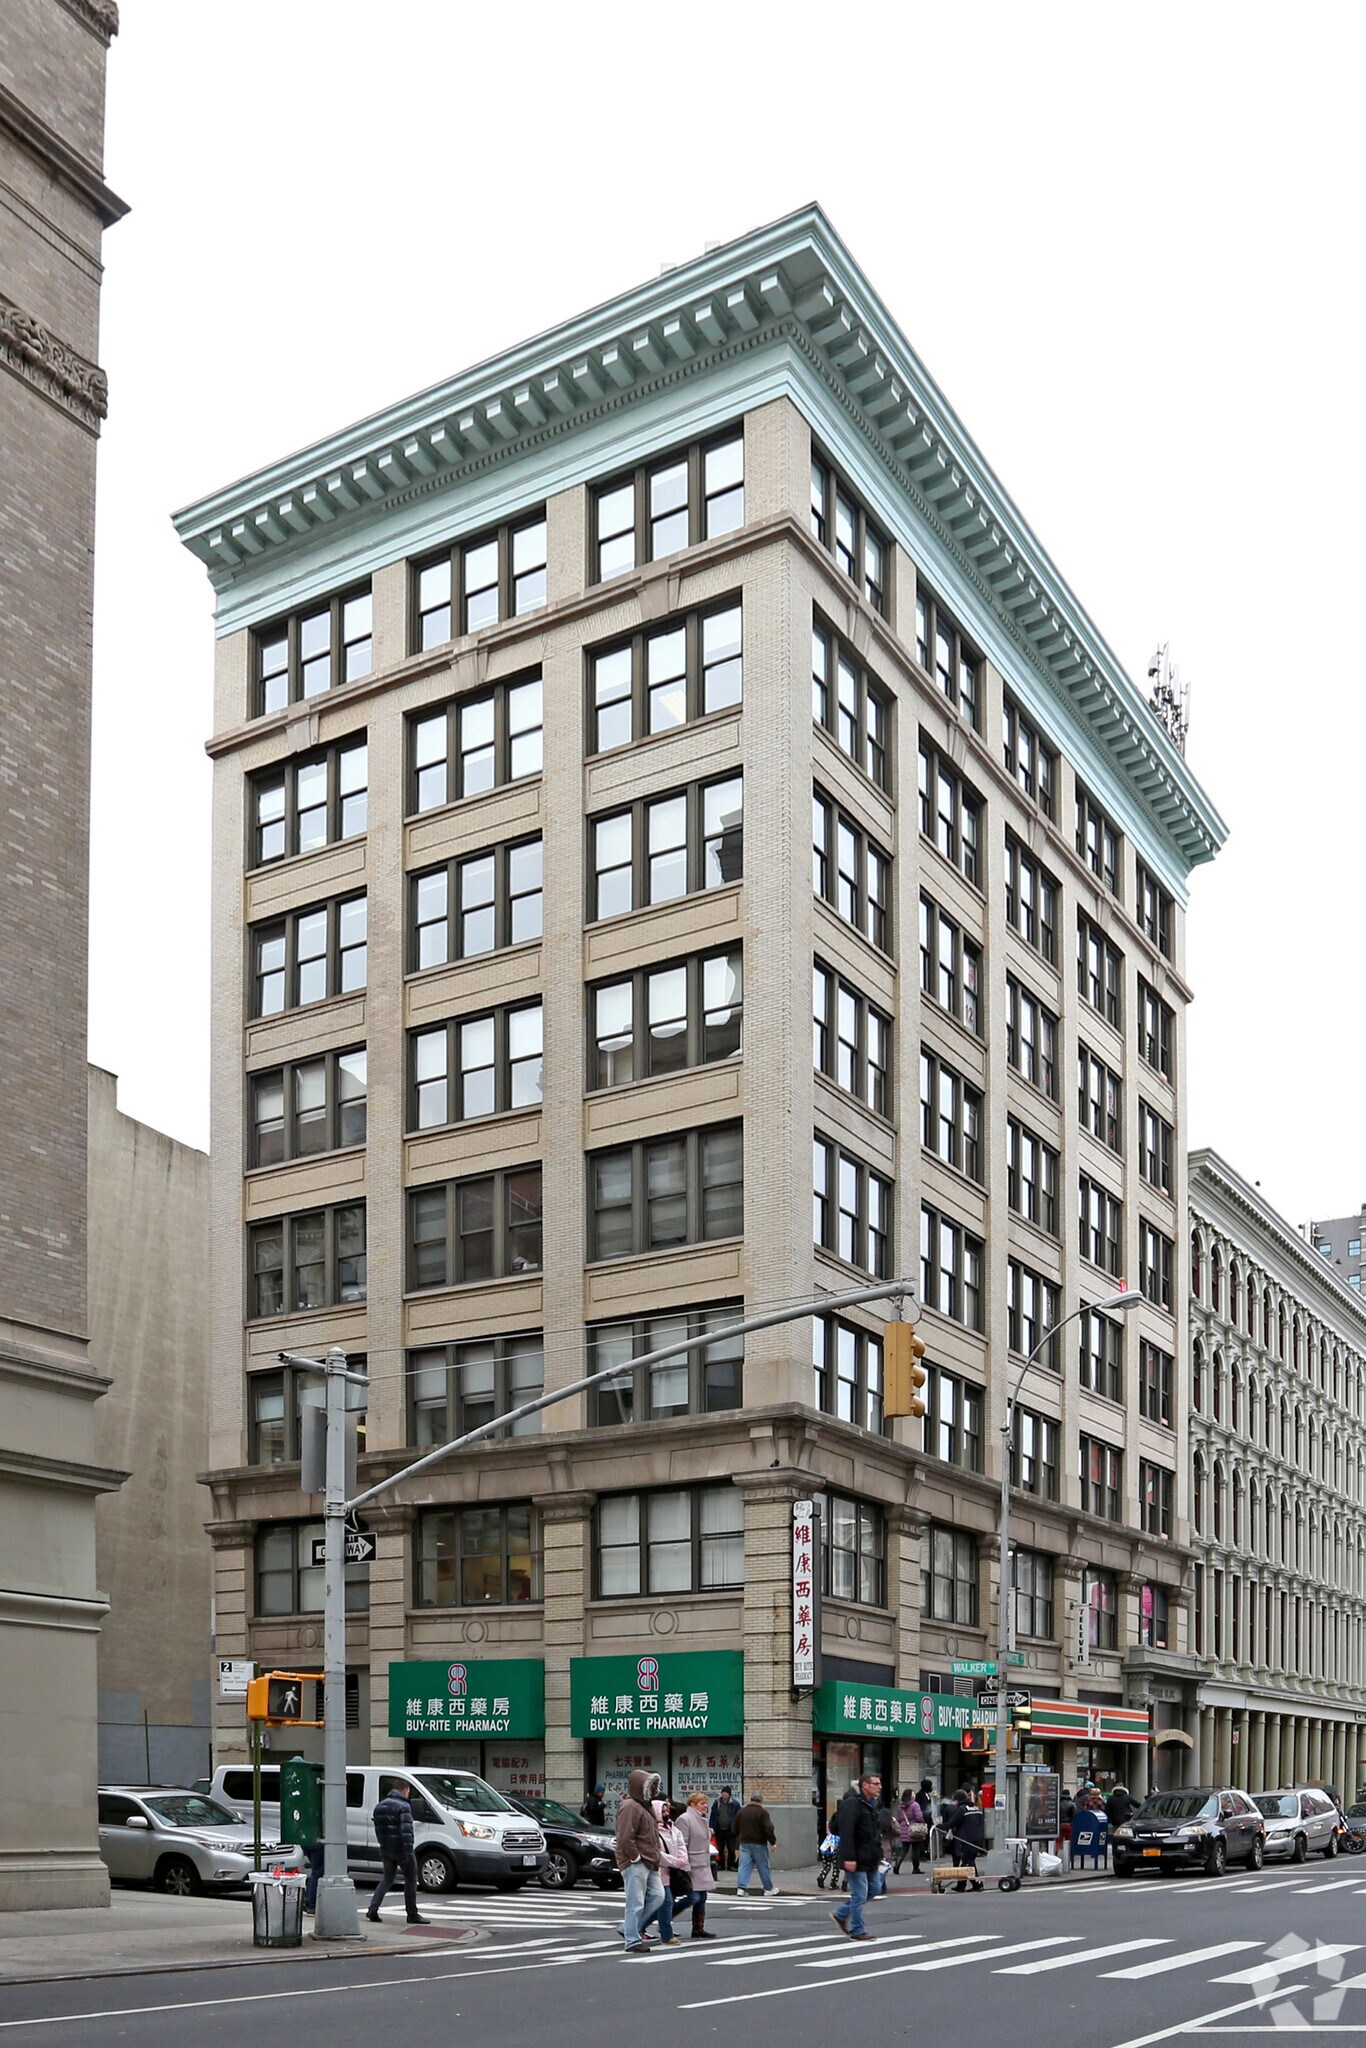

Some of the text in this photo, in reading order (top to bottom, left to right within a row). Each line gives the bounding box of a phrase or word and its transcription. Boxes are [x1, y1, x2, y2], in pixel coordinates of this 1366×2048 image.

[347, 1543, 366, 1555] WAY
[795, 1525, 811, 1656] 維康西藥房
[953, 1663, 987, 1673] WALKER
[406, 1697, 510, 1716] 維康西藥房
[590, 1691, 709, 1715] 維康西藥房
[1007, 1695, 1023, 1703] WAY
[843, 1694, 917, 1725] 維康西藥房
[938, 1705, 970, 1728] BUY-RITE
[406, 1719, 510, 1731] BUY-RITE PHARMACY
[590, 1715, 708, 1731] BUY-RITE PHARMACY
